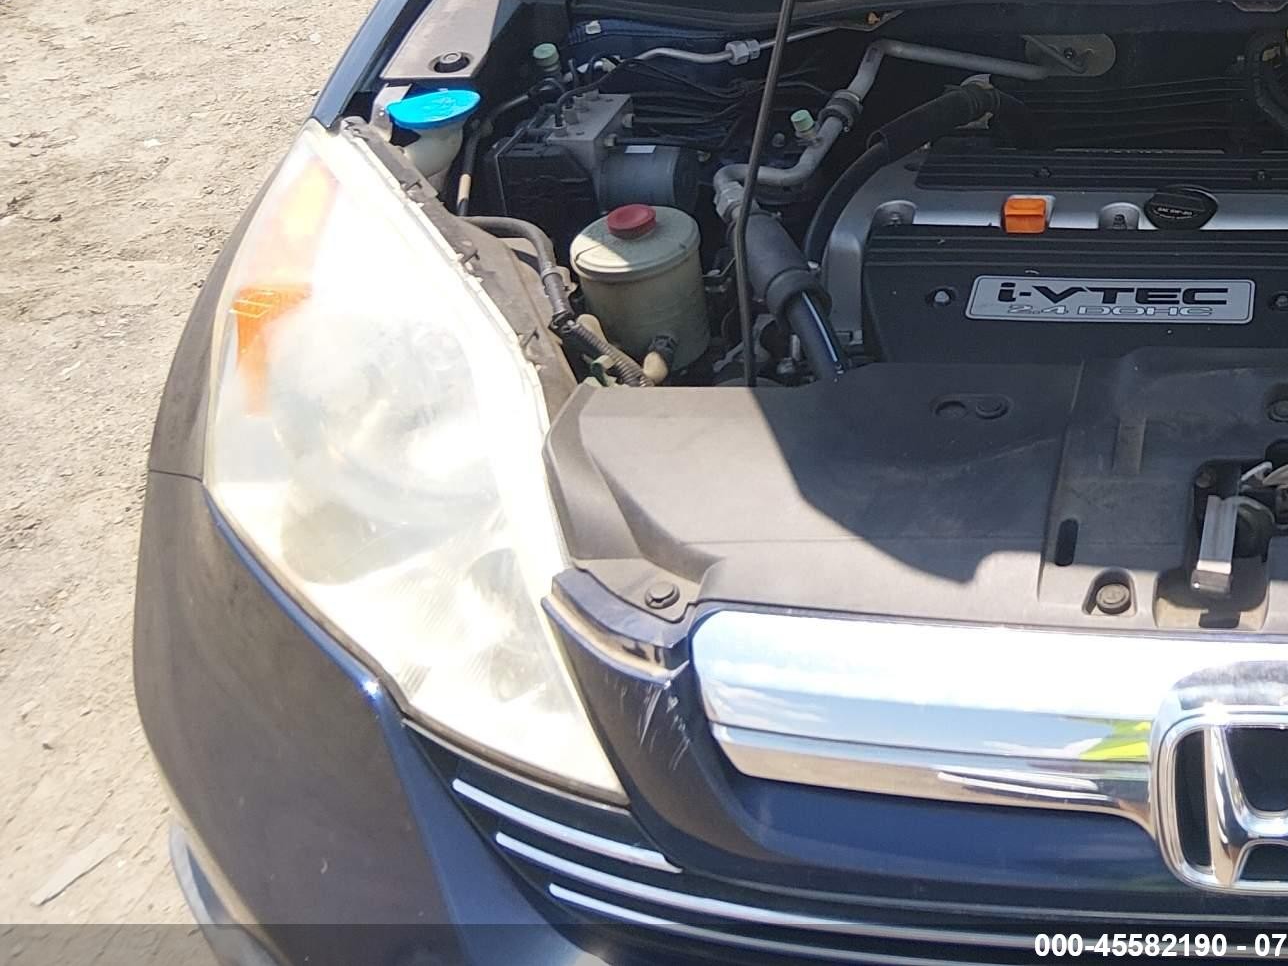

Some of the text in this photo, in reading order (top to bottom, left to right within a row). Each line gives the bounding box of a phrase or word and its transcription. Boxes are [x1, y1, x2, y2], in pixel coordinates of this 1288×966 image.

[997, 282, 1229, 305] i-VTEC
[1007, 304, 1213, 317] 2.4 DOHC
